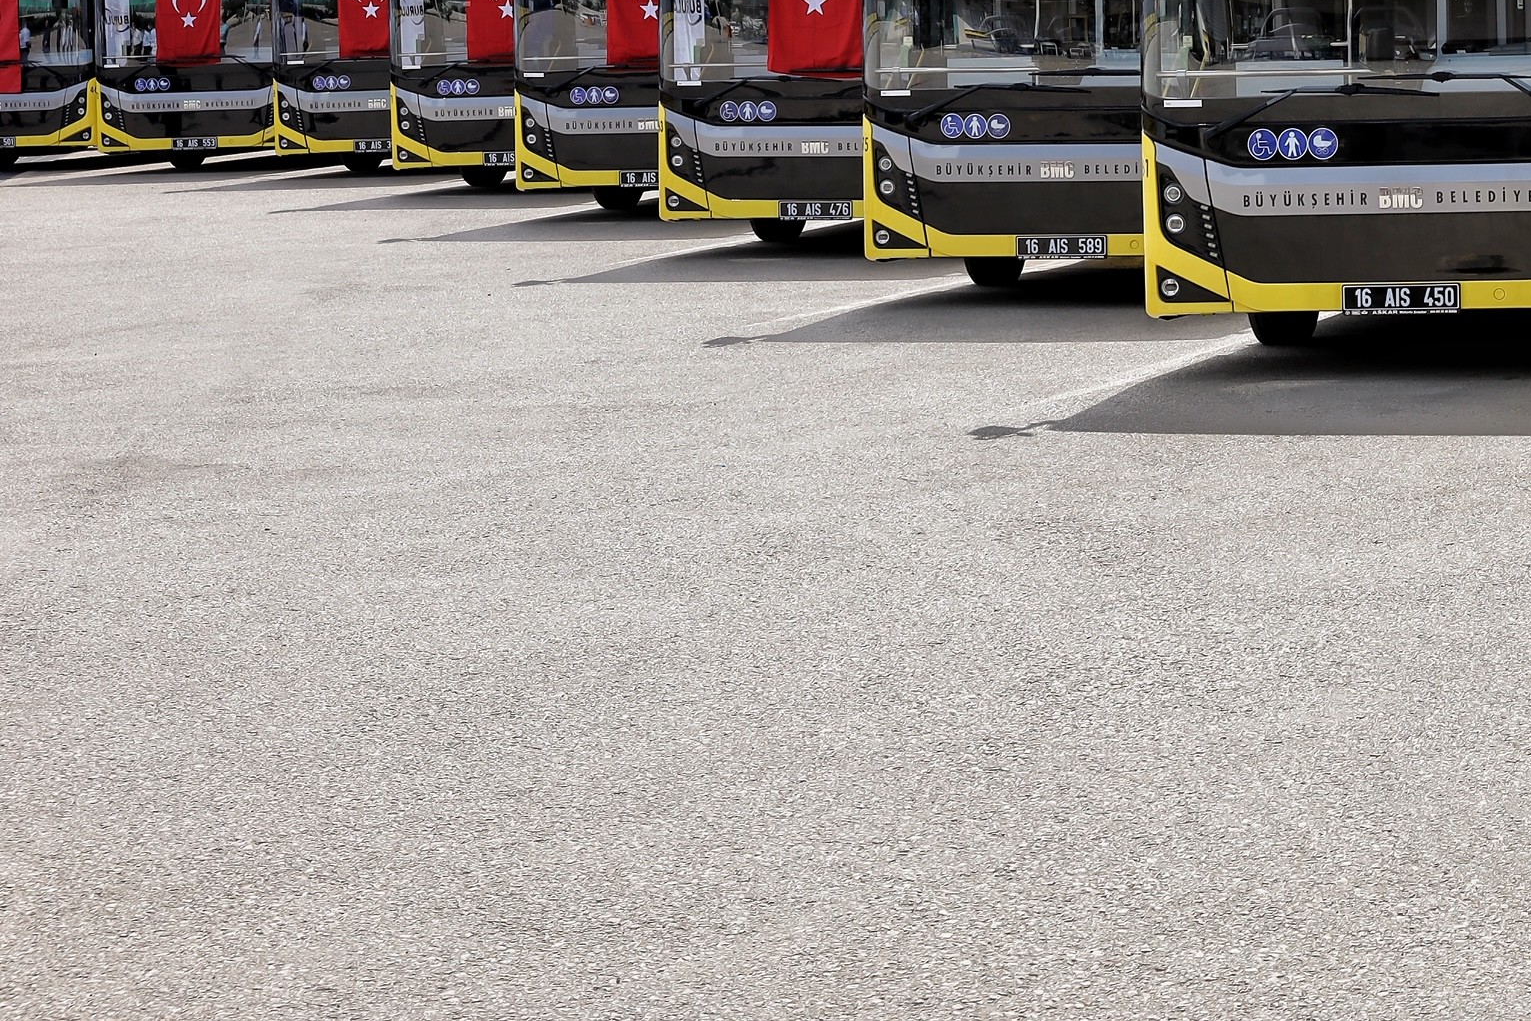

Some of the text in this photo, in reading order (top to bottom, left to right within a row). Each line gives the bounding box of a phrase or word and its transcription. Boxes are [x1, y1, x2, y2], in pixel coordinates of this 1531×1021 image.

[131, 99, 254, 110] BÜYÜKŞEHİR BMC BELEDİYESİ
[309, 98, 387, 111] BÜYÜKŞEHİR BMC
[434, 106, 493, 117] BÜYÜKŞEHİR
[565, 120, 633, 131] BÜYÜKŞEHİR
[187, 139, 199, 147] AIS
[202, 138, 215, 147] 553
[358, 141, 366, 150] 16
[370, 140, 382, 150] AIS
[715, 140, 793, 153] BÜYÜKŞEHİR
[801, 140, 829, 154] BMC
[837, 142, 859, 151] BEL
[488, 153, 515, 163] 16 AIS
[936, 162, 1032, 178] BÜYÜKŞEHİR
[1040, 160, 1075, 179] BMC
[1084, 162, 1139, 176] BELEDİ
[626, 172, 656, 183] 16 AIS
[1242, 189, 1368, 210] BÜYÜKŞEHİR
[1379, 186, 1423, 210] BMC
[786, 203, 849, 215] 16 AIS 476
[1025, 238, 1102, 254] 16 AIS 589
[1355, 286, 1455, 308] 16 AIS 450
